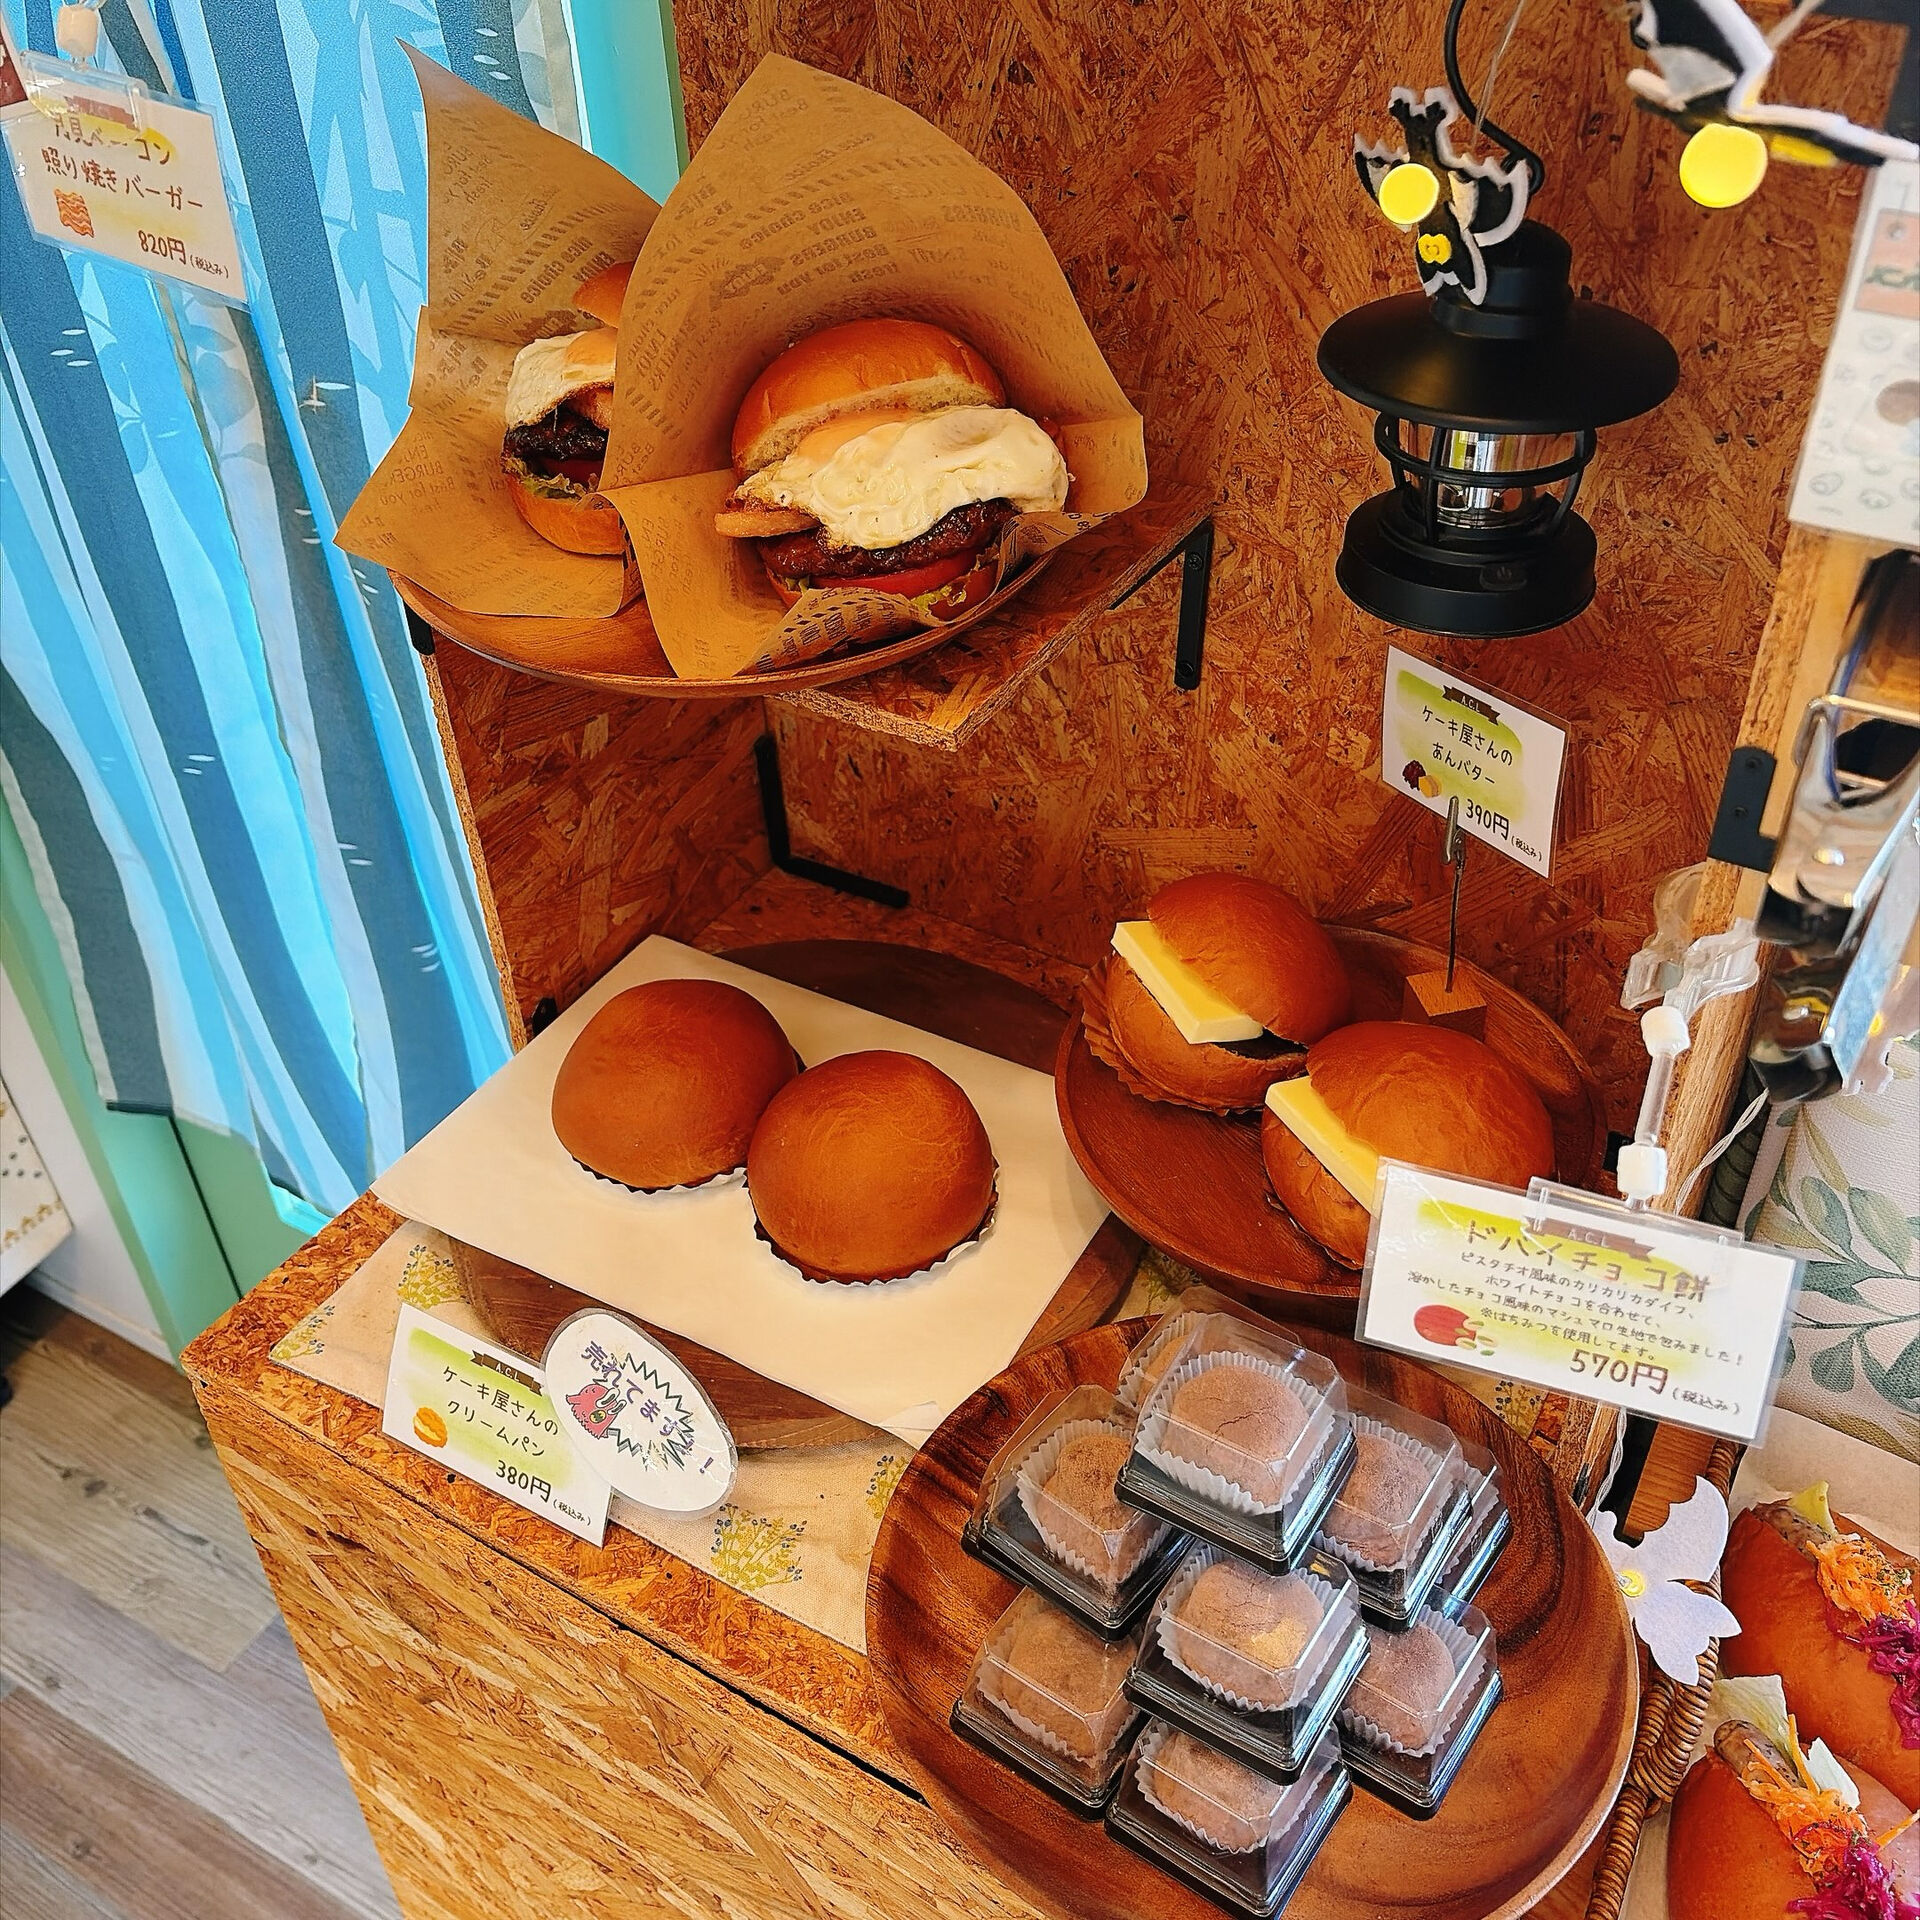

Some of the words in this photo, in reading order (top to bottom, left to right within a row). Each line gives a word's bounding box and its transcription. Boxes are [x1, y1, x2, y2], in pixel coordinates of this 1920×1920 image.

[40, 146, 204, 211] 照り焼きバーガー
[1421, 705, 1513, 767] ケーキ屋さんの
[1431, 742, 1496, 785] あんバター
[1465, 798, 1510, 840] 390円
[1569, 1349, 1669, 1395] 570円
[442, 1366, 559, 1436] ケーキ屋さんの
[447, 1401, 546, 1457] クリームパン
[495, 1459, 552, 1503] 380円
